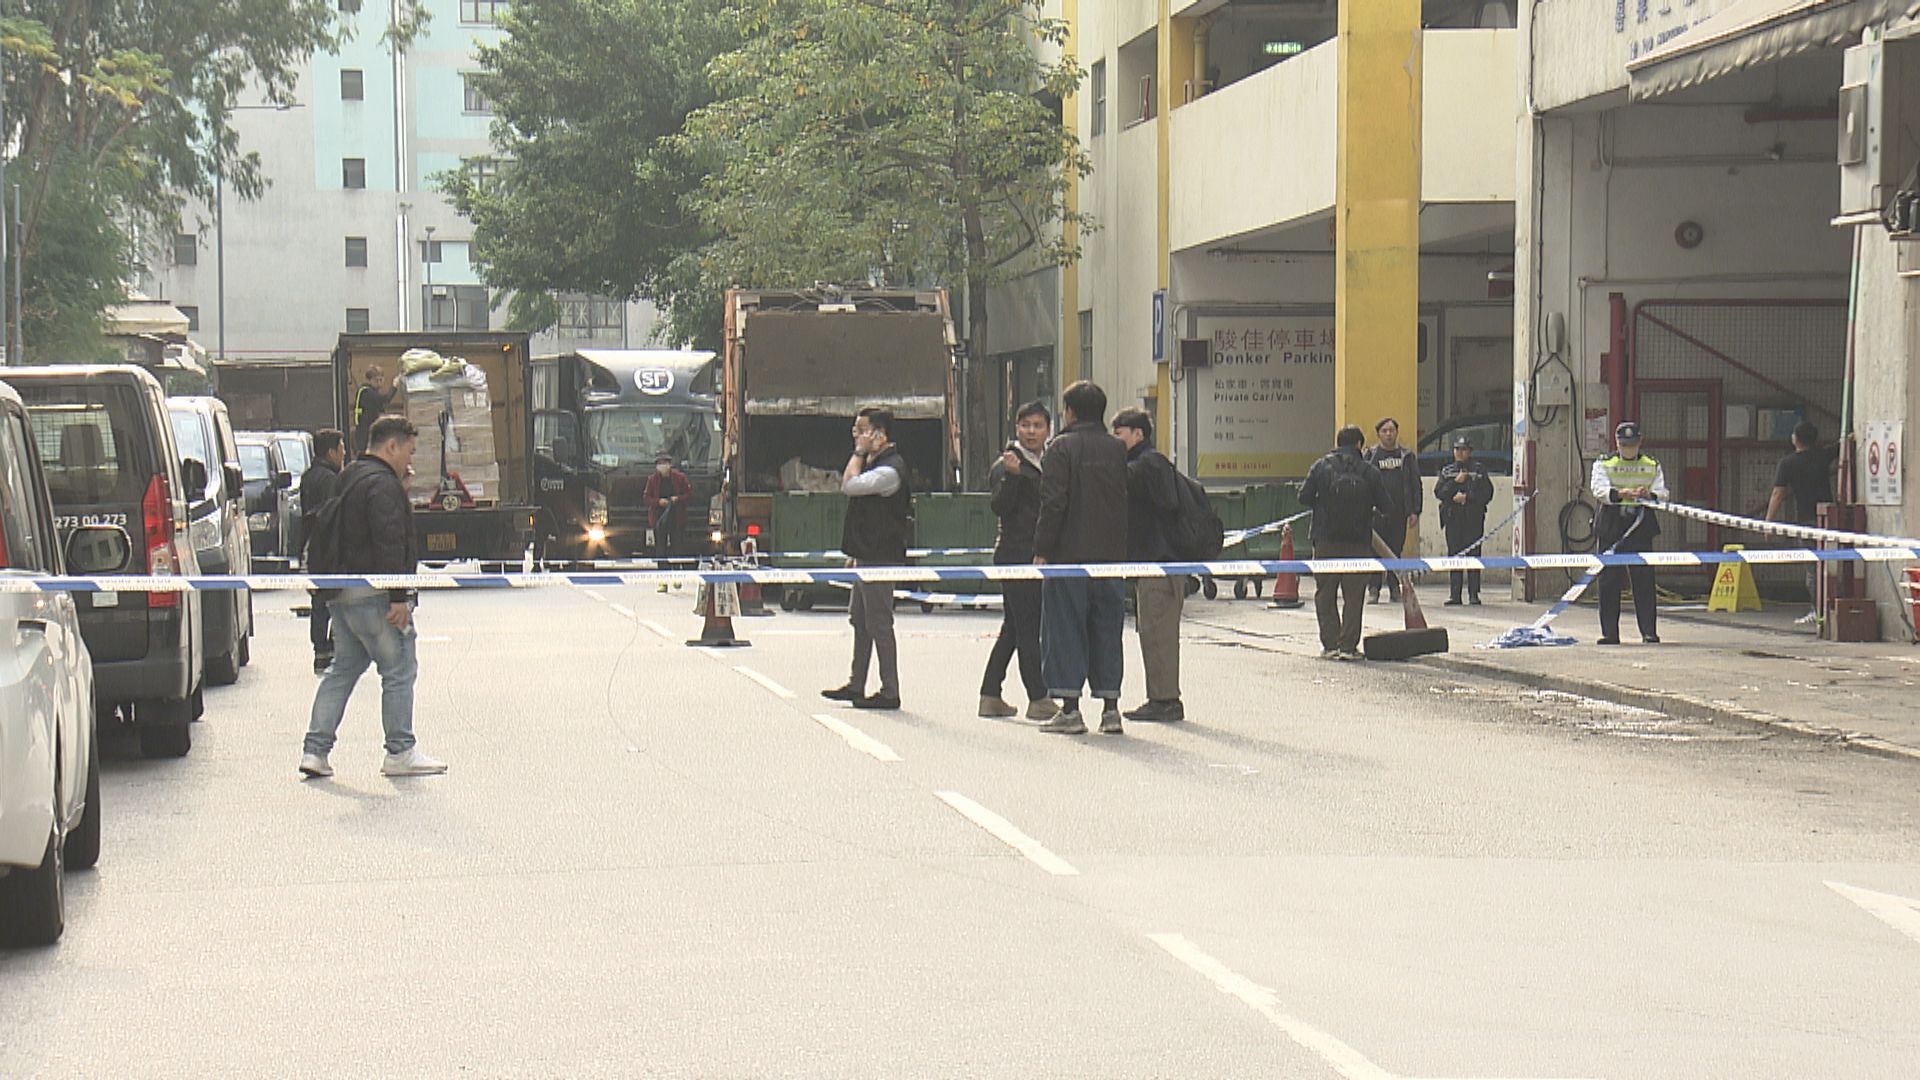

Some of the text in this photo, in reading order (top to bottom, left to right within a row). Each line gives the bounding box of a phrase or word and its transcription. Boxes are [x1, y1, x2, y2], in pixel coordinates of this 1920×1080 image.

[1214, 351, 1335, 365] Denker Parkin
[54, 513, 127, 529] 273 00 273
